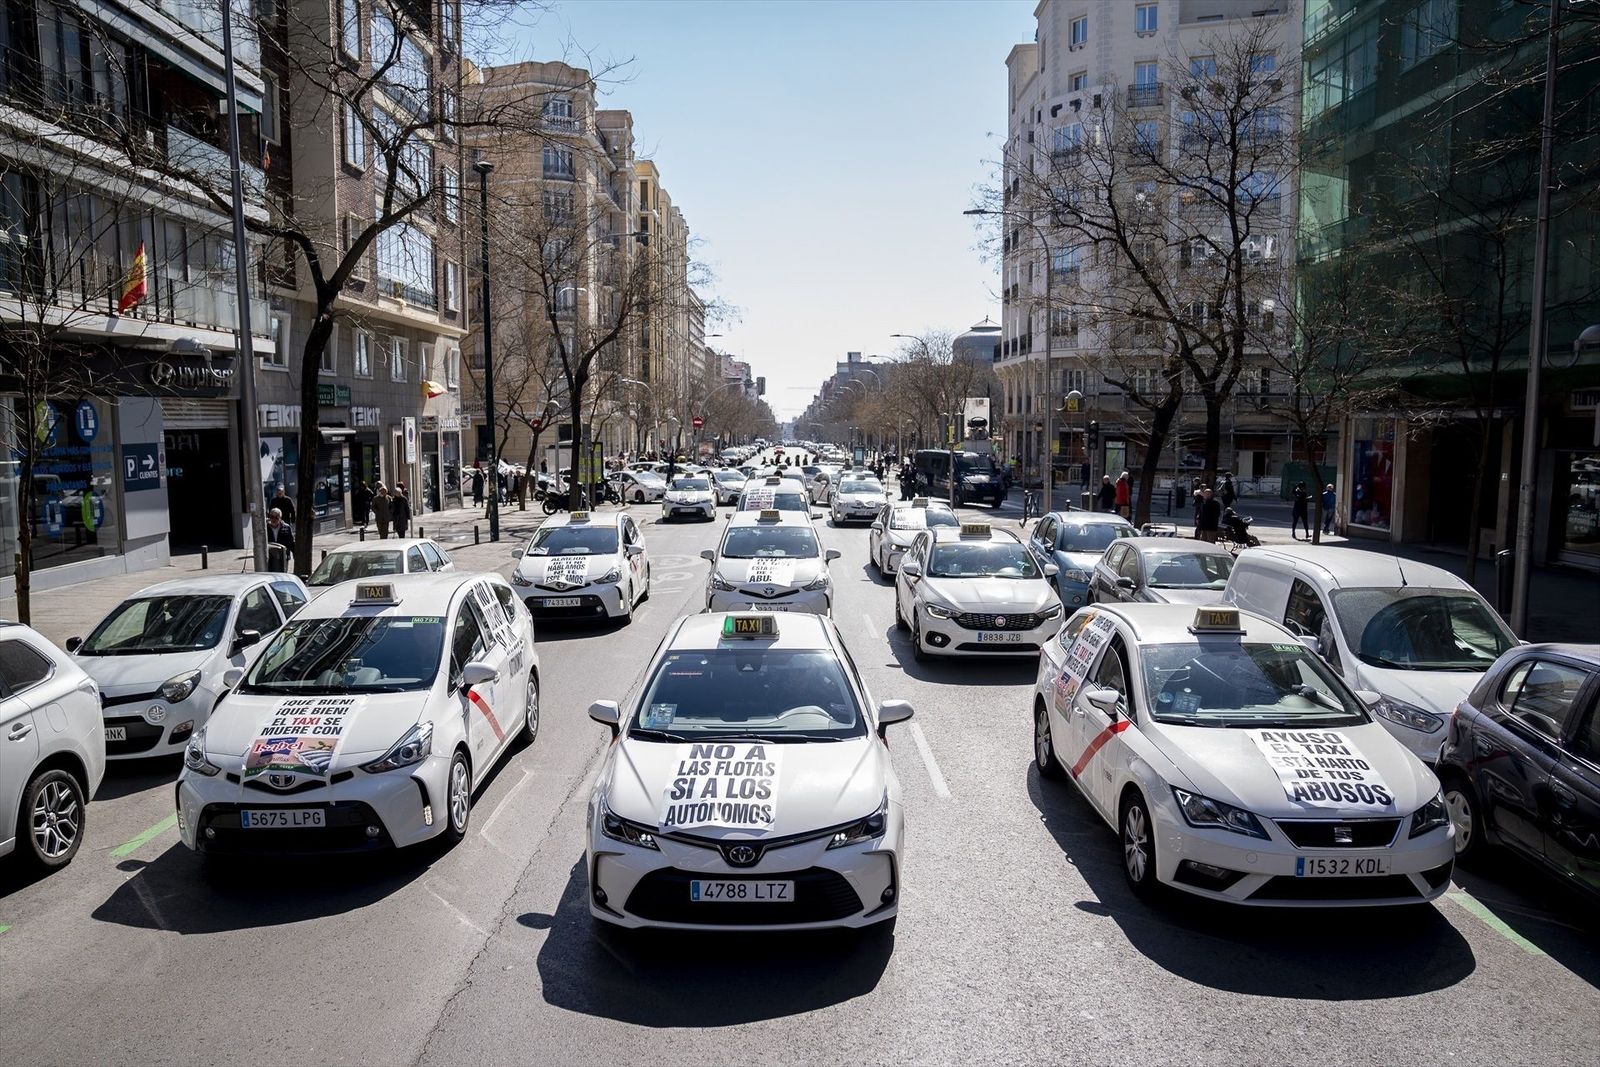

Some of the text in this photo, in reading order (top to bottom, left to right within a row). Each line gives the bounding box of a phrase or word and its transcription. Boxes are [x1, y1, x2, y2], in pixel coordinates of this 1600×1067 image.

[127, 458, 136, 478] P
[139, 470, 158, 479] CLIENTES
[547, 564, 586, 572] HABLAMOS
[365, 586, 384, 599] TAXI
[1209, 612, 1231, 625] TAXI
[736, 620, 759, 633] TAXI
[983, 633, 1004, 642] 8838
[317, 698, 355, 706] BIEN!
[311, 707, 349, 715] BIEN!
[272, 717, 342, 726] EL TAXI SE
[260, 726, 343, 736] MUERE CON
[1261, 731, 1344, 744] AYUSO
[254, 741, 304, 753] Isabel
[689, 744, 766, 760] NO A
[1271, 743, 1351, 756] EL TAXI
[677, 761, 776, 777] LAS FLOTAS
[1315, 757, 1370, 771] HARTO
[1295, 769, 1365, 781] DE TUS
[670, 778, 772, 800] SI A LOS
[1291, 781, 1392, 806] ABUSOS
[251, 811, 322, 826] 5675 LPG
[664, 799, 774, 826] AUTÓNOMOS
[1309, 858, 1386, 875] 1532 KDL
[704, 883, 788, 899] 4788 LTZ
